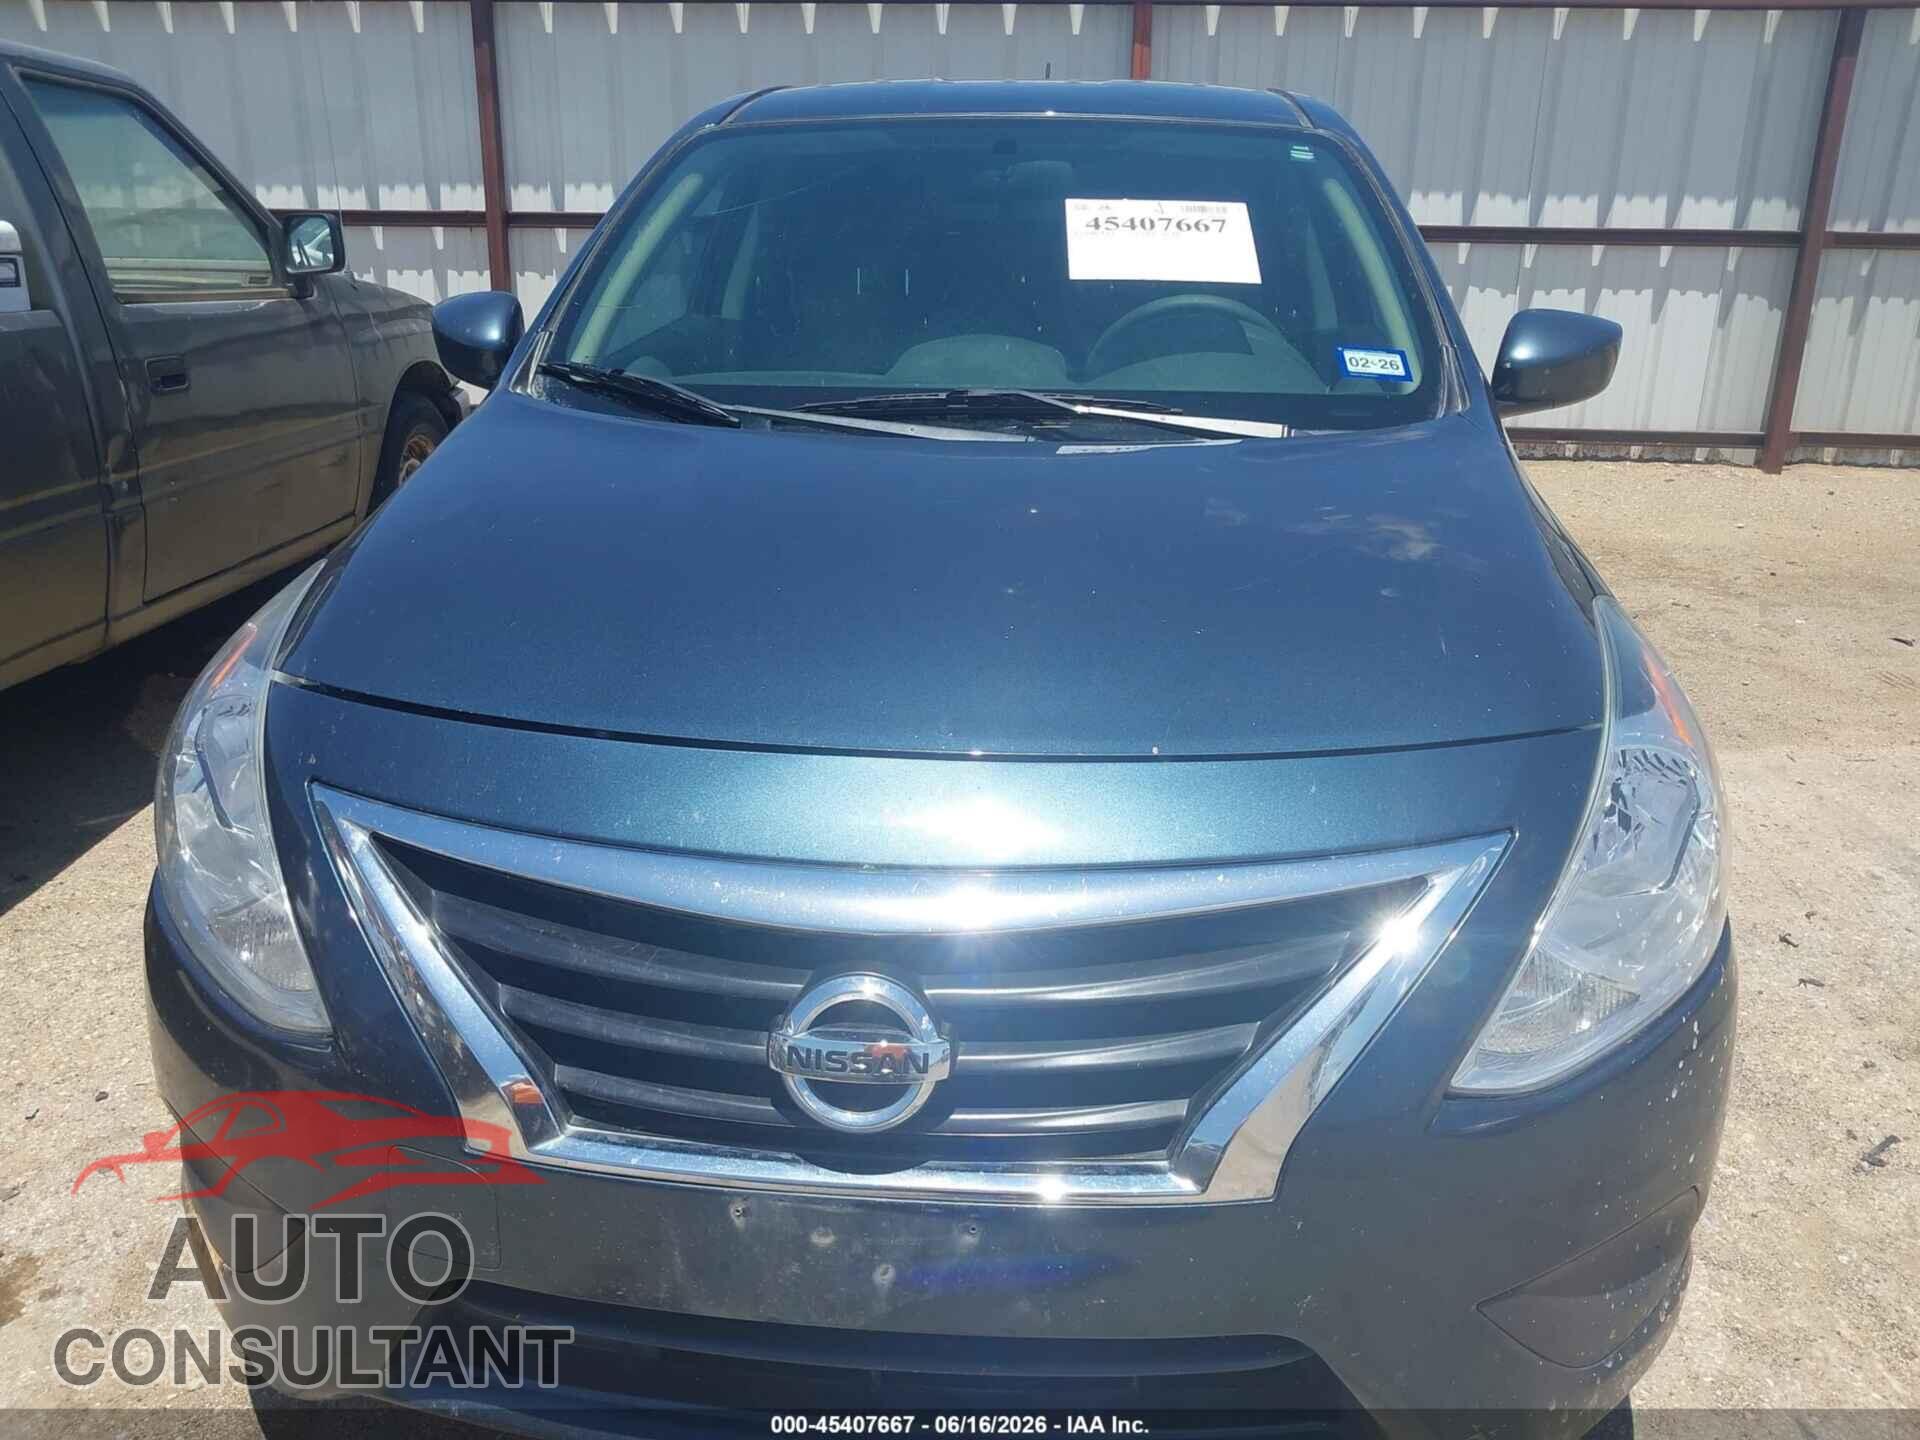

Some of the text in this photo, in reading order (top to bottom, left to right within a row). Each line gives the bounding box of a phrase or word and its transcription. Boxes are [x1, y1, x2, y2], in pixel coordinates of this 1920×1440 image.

[1085, 216, 1226, 233] 45407667
[1348, 357, 1400, 371] 02 26
[786, 1046, 930, 1075] NISSAN
